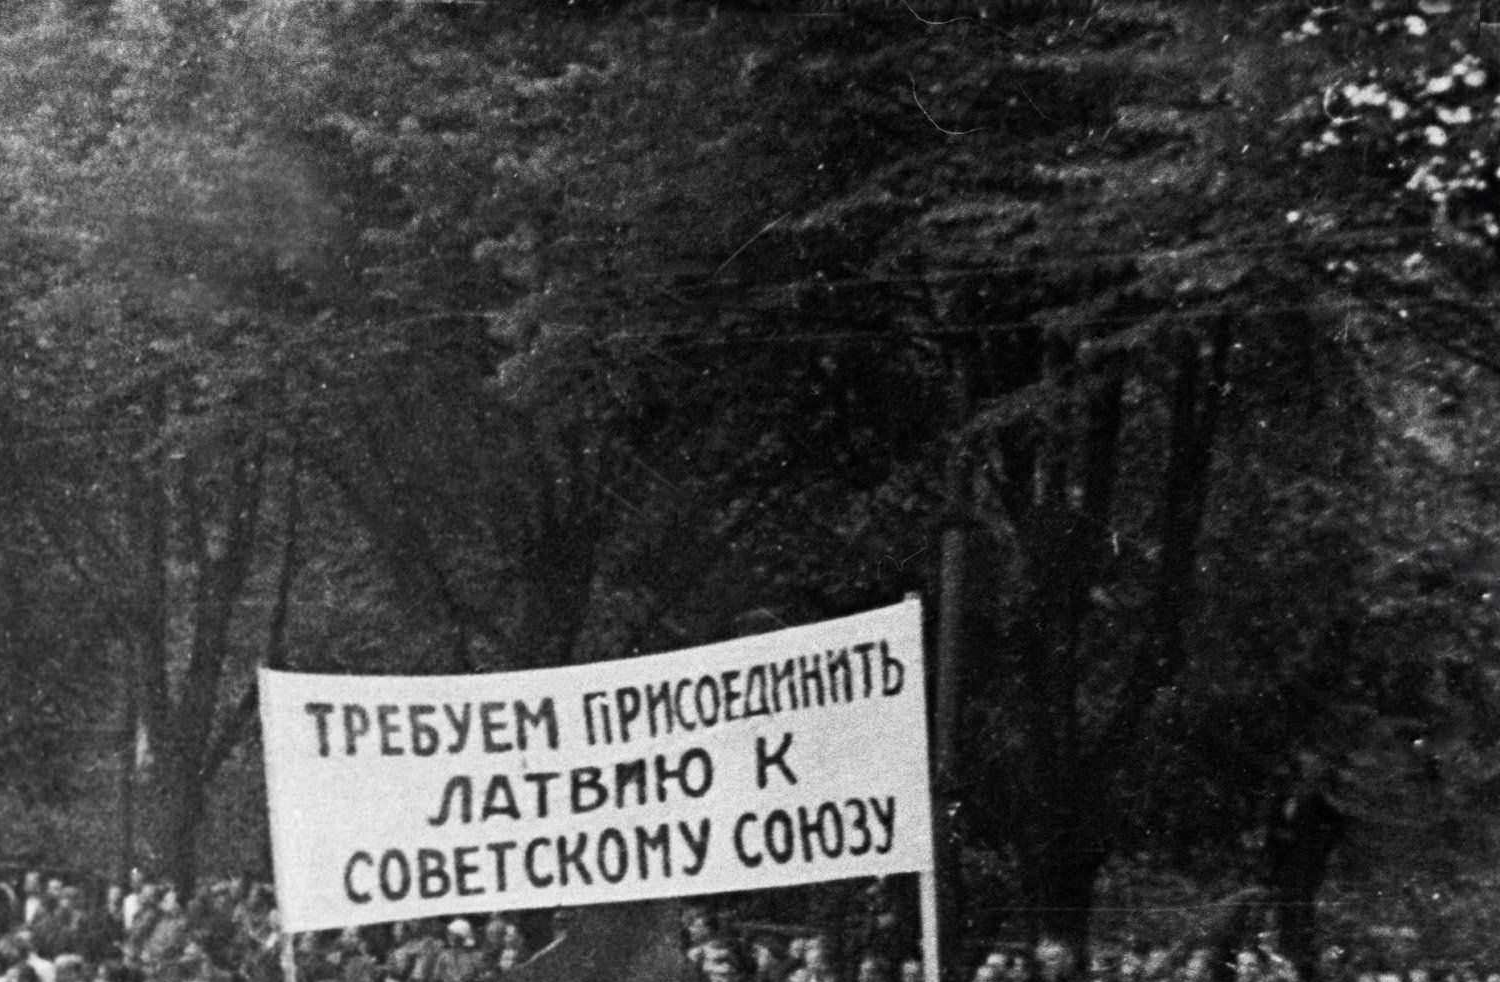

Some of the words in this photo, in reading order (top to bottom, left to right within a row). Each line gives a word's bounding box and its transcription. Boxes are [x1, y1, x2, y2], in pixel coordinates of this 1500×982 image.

[305, 697, 559, 757] ТРЕБУЕМ
[582, 640, 905, 745] ПРИСОЕДИНИТЬ
[428, 747, 714, 826] ЛАТВИЮ
[755, 732, 798, 789] К
[344, 818, 711, 903] СОВЕТСКОМУ
[733, 796, 896, 868] СОЮЗУ
